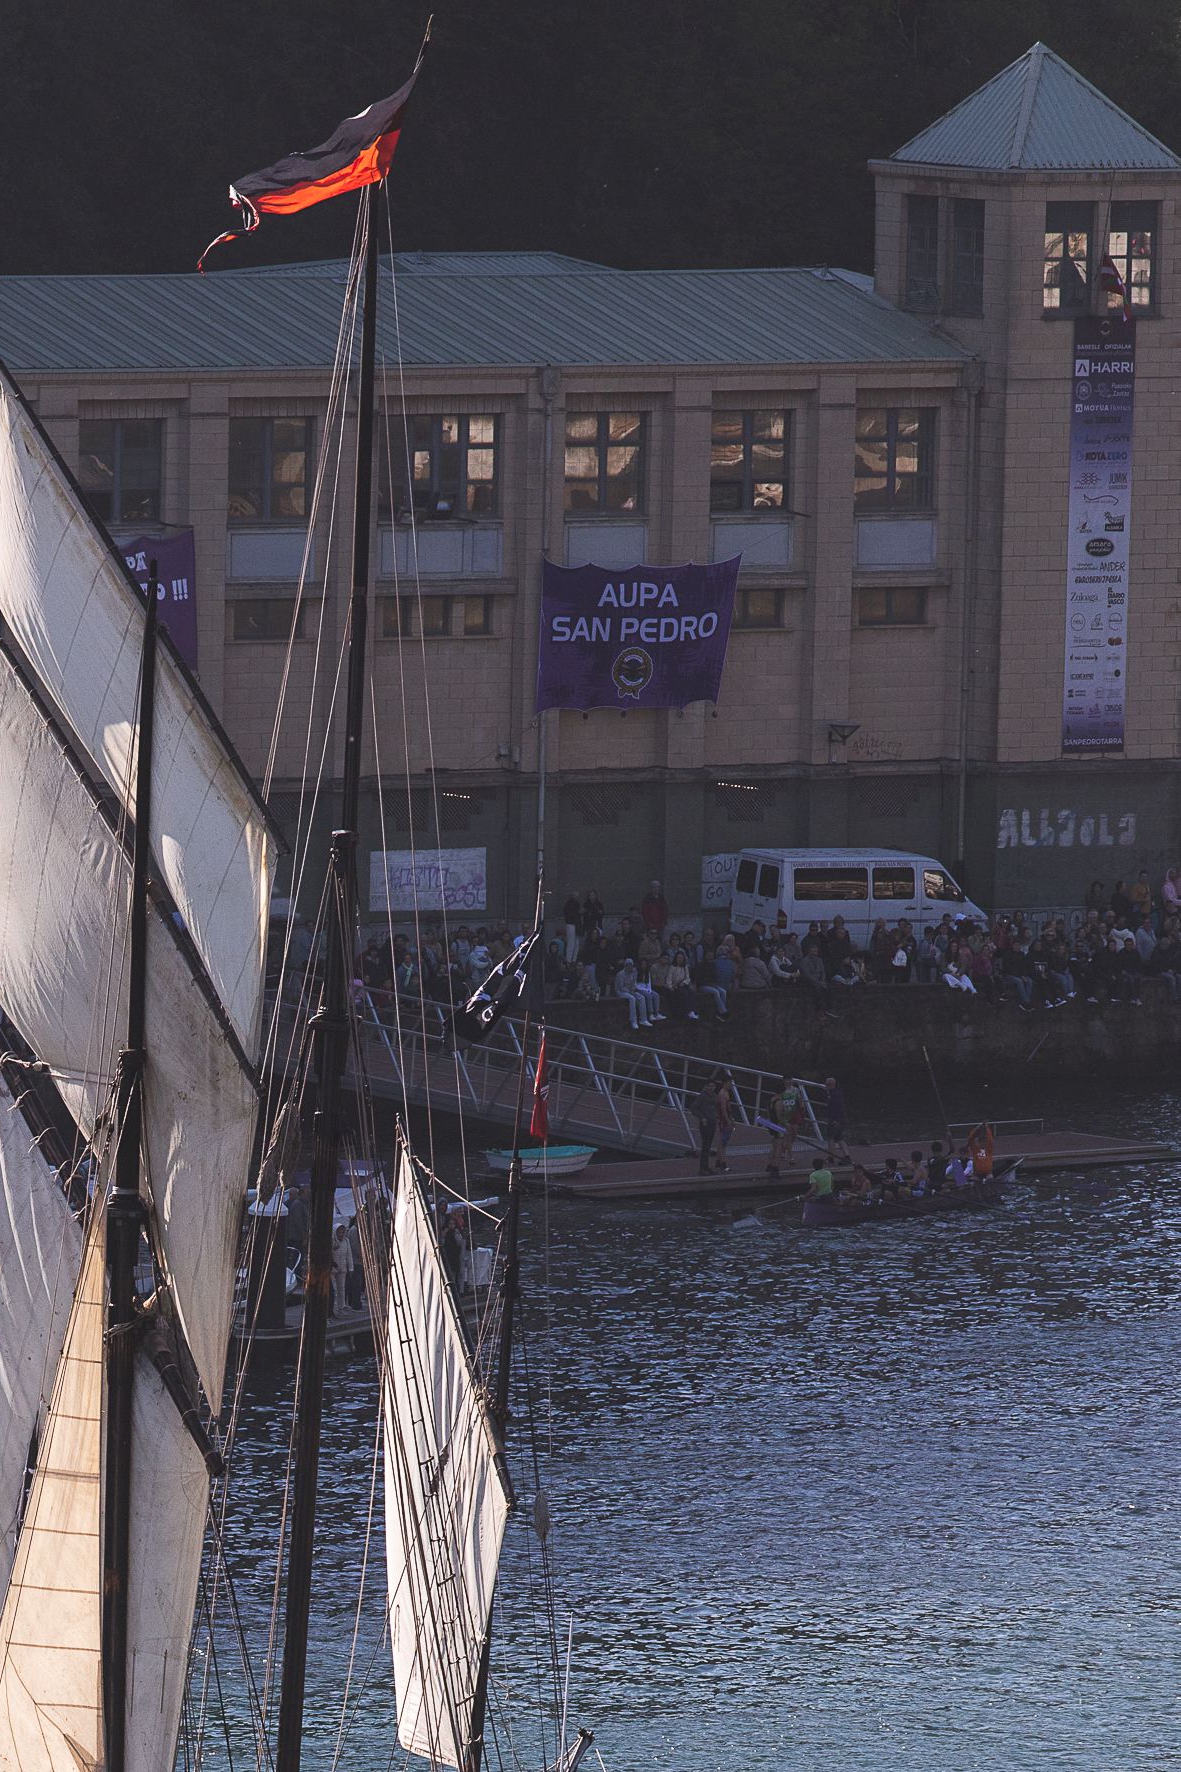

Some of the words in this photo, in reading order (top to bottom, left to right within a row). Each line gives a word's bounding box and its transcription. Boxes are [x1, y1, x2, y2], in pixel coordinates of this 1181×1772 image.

[1091, 361, 1134, 373] HARRI
[1099, 561, 1126, 572] ANDER
[598, 582, 679, 607] AUPA
[552, 616, 611, 642] SAN
[620, 611, 718, 642] PEDRO
[1064, 738, 1123, 746] SANPEDROTARRA
[706, 886, 724, 900] GO
